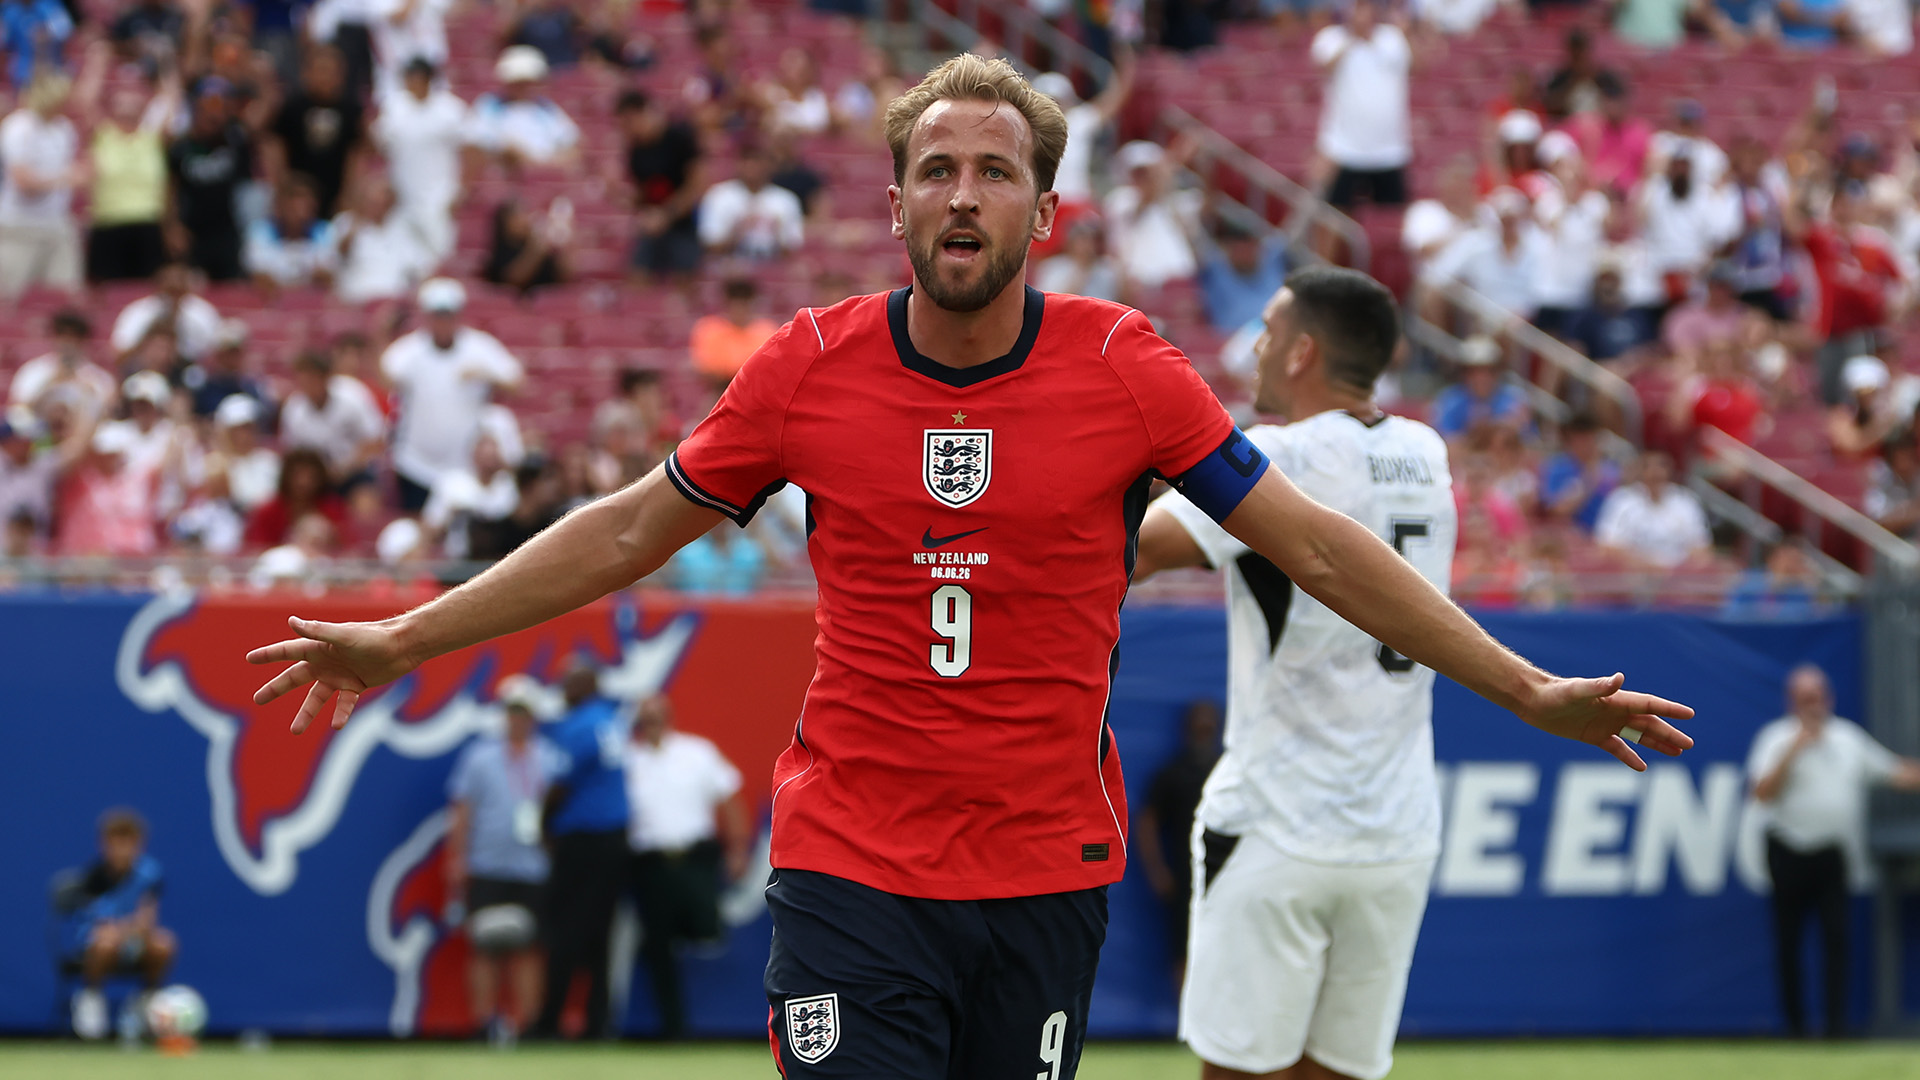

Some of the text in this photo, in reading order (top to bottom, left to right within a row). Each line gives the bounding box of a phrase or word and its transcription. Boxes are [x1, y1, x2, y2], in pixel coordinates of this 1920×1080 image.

[1220, 429, 1262, 478] C
[912, 552, 989, 565] NEW ZEALAND
[930, 566, 971, 580] 06.06.26
[929, 584, 972, 678] 9
[1036, 1009, 1068, 1080] 9
